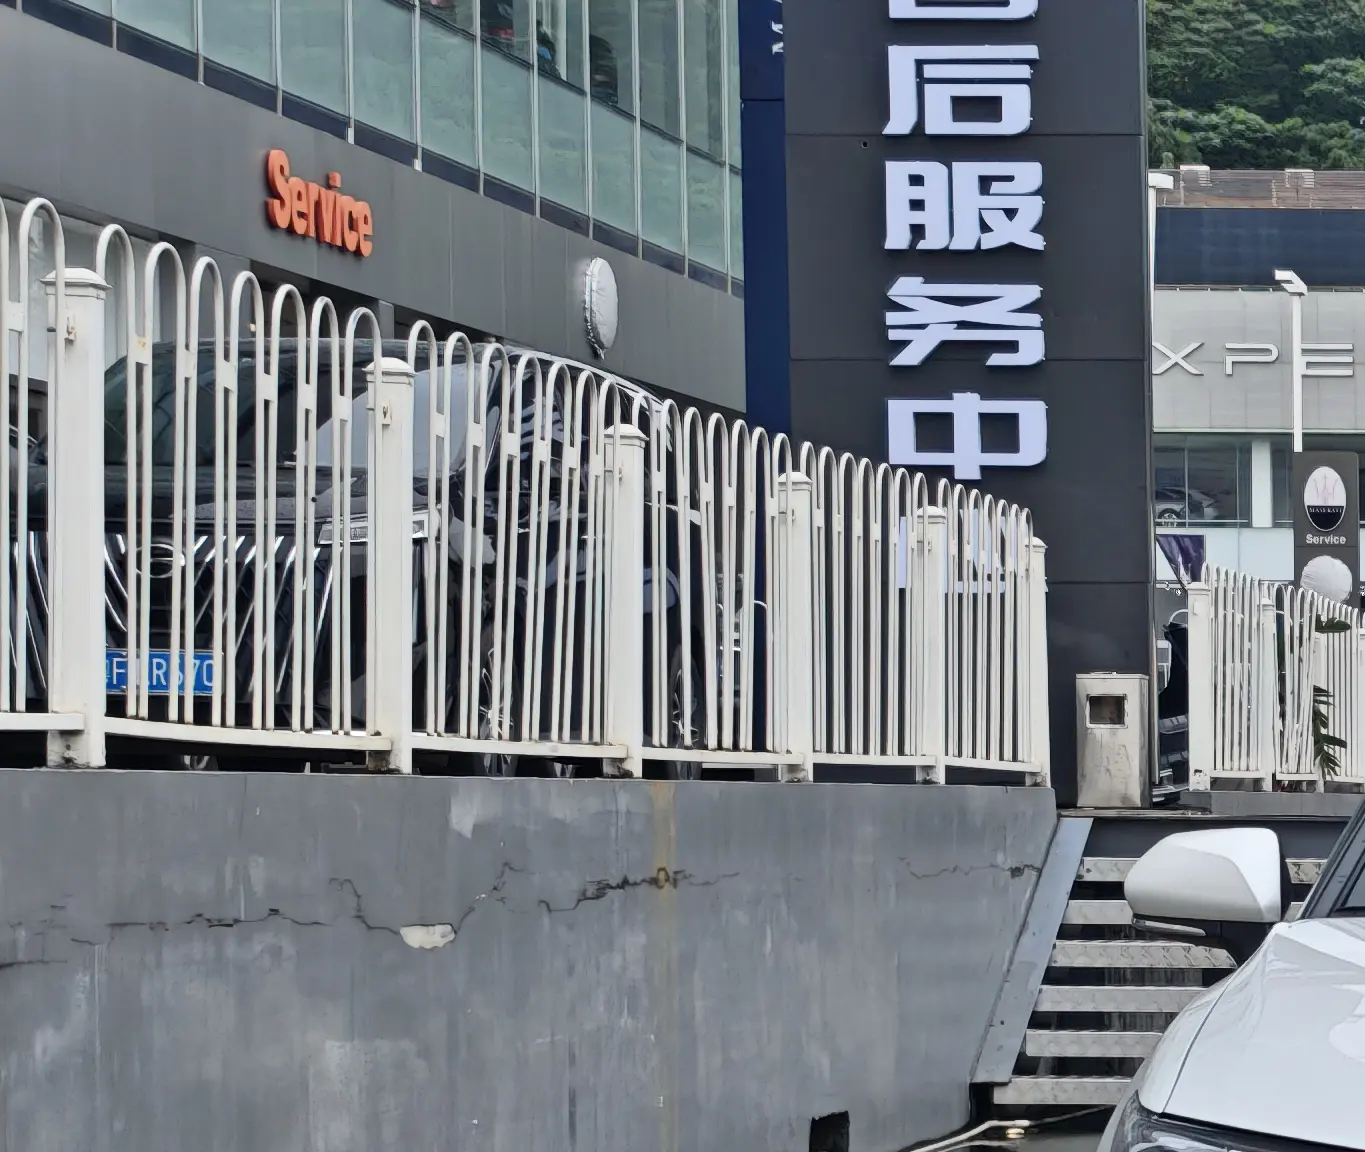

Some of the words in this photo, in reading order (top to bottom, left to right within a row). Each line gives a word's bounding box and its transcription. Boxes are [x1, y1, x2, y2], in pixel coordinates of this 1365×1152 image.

[266, 149, 373, 257] Service
[882, 0, 1048, 593] 后服务中
[1305, 533, 1347, 545] Service
